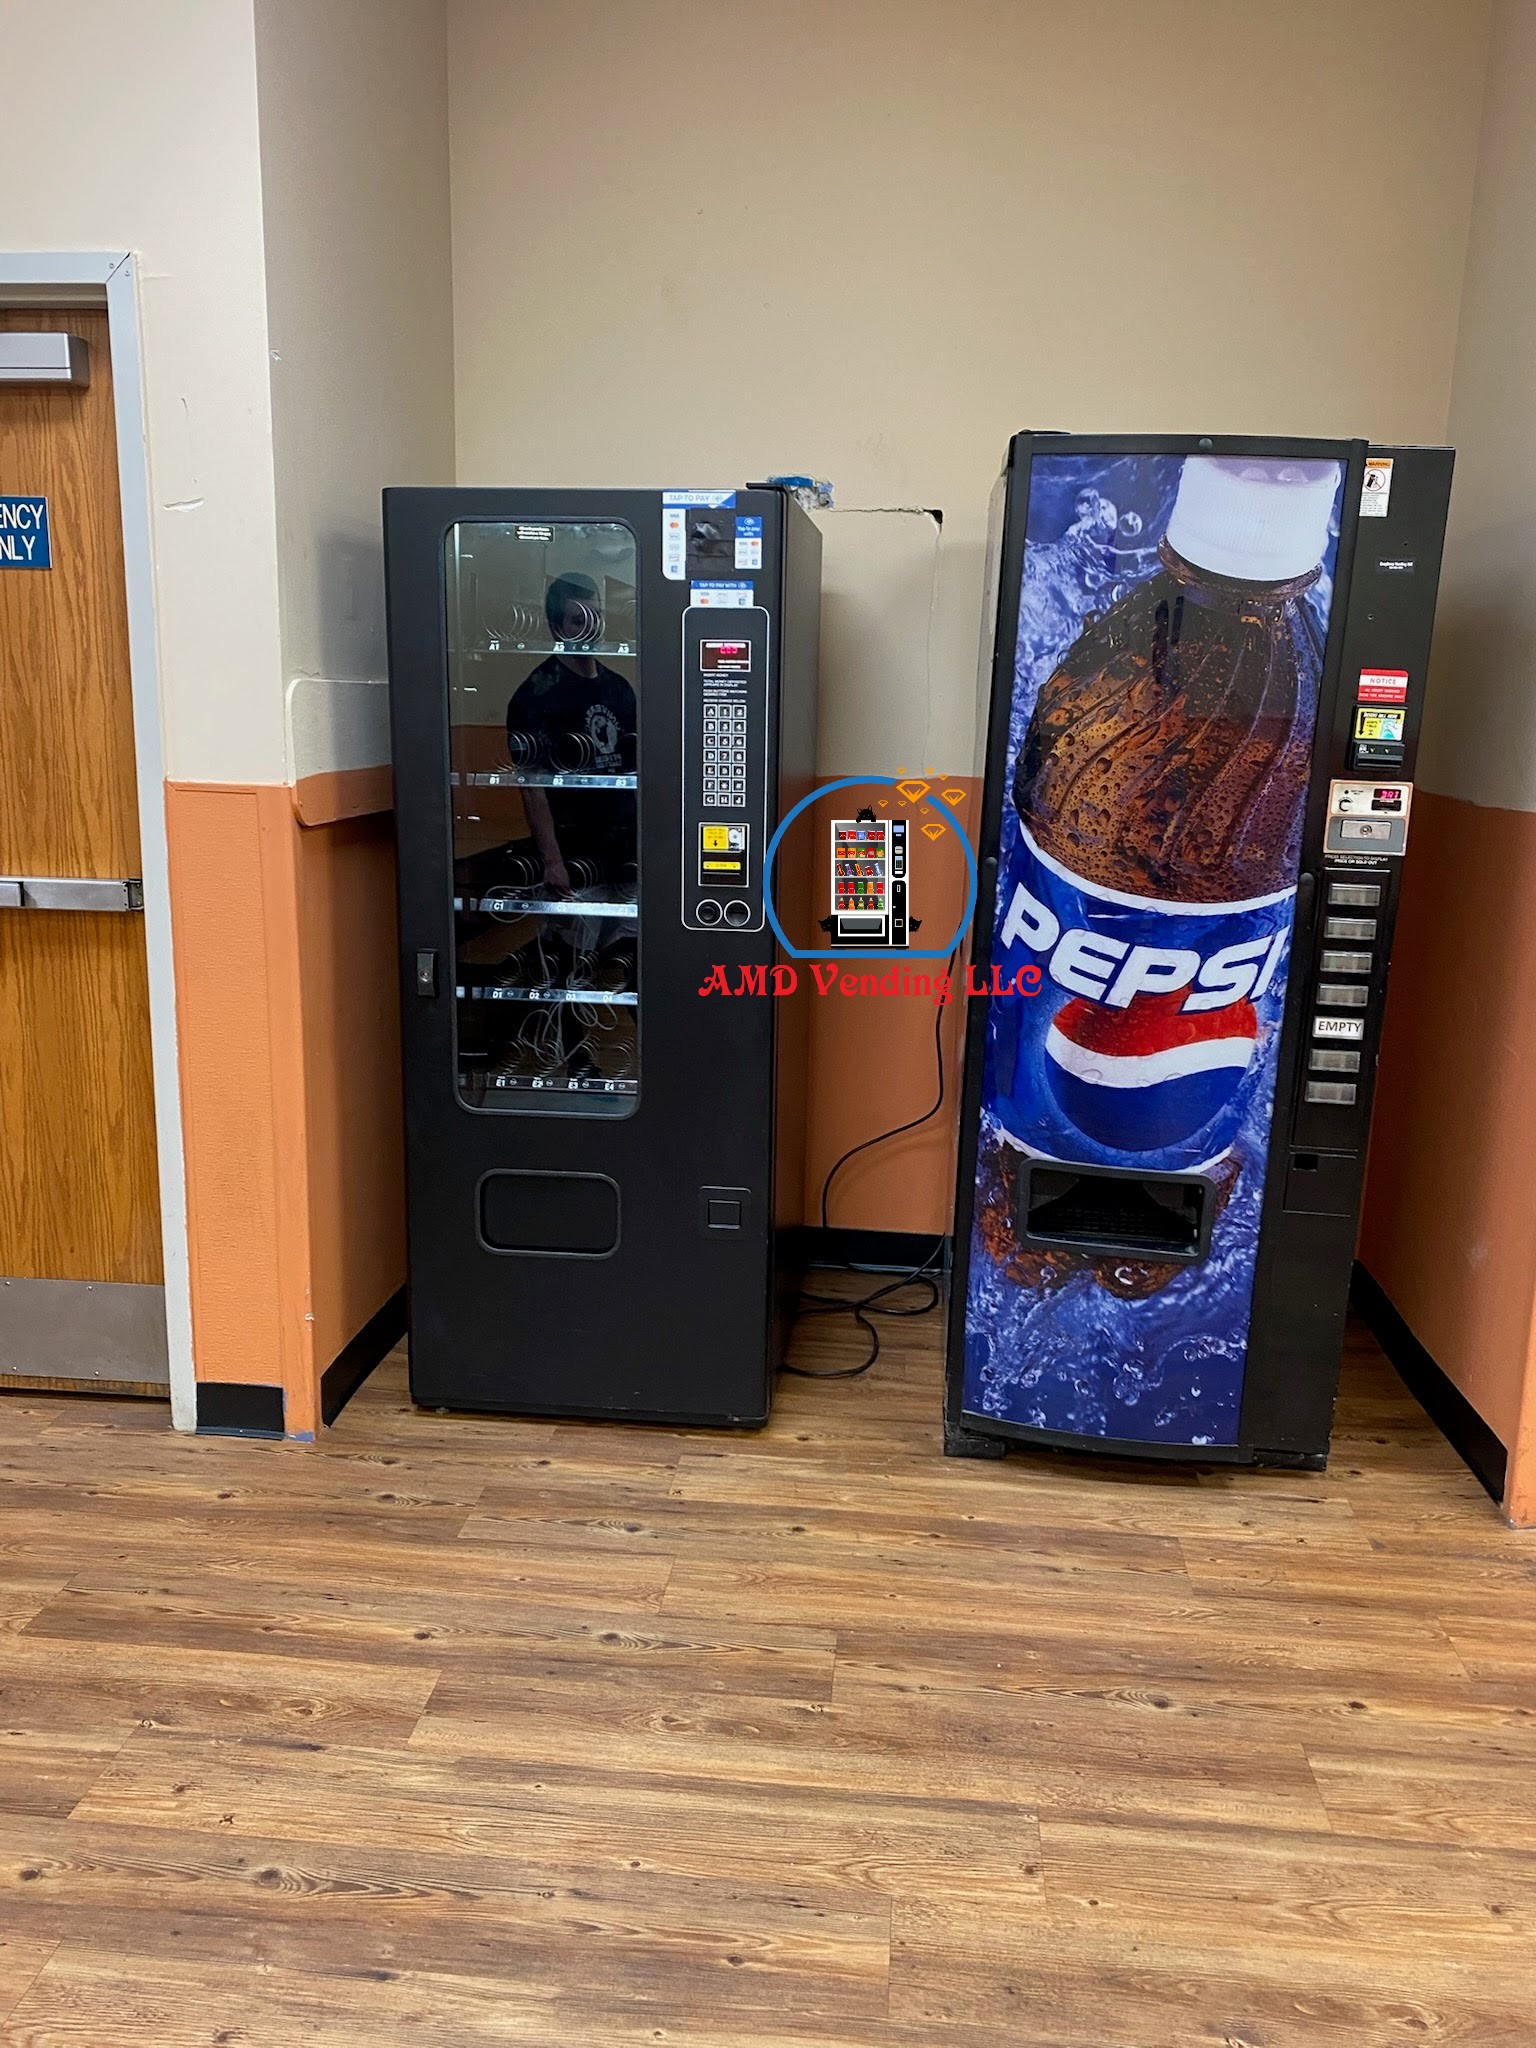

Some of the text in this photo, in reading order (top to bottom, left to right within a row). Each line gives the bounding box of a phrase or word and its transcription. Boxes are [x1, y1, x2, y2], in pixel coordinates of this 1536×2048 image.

[553, 644, 565, 652] A2
[618, 646, 630, 654] A3
[493, 902, 504, 910] C1
[1000, 882, 1291, 1012] PEPSI
[1318, 1021, 1362, 1032] EMPTY
[496, 1079, 506, 1087] E1
[568, 1081, 578, 1089] E3
